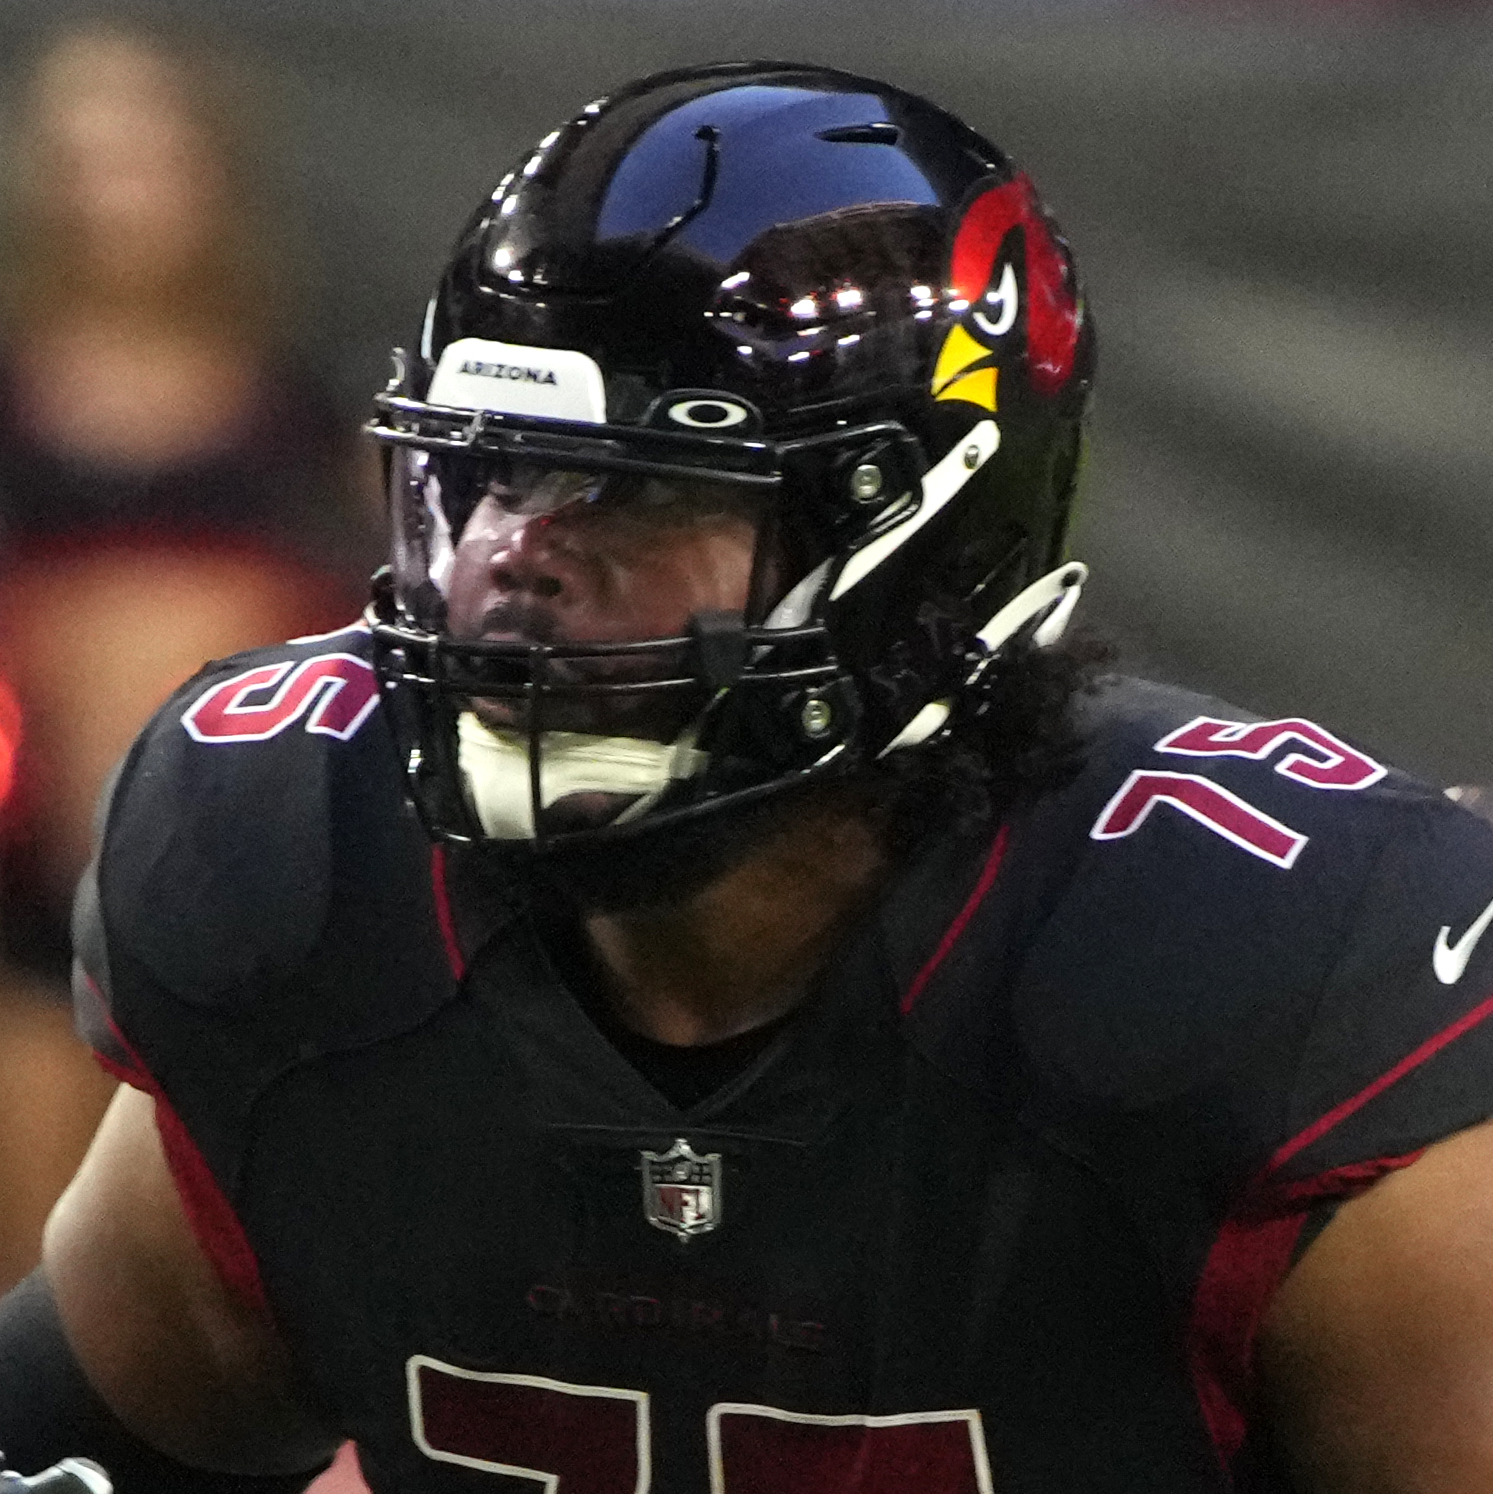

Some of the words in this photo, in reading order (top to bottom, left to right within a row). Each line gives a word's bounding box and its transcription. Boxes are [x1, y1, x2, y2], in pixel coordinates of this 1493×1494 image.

[459, 360, 558, 386] ARIZONA
[180, 625, 382, 744] 5
[1089, 715, 1389, 870] 75
